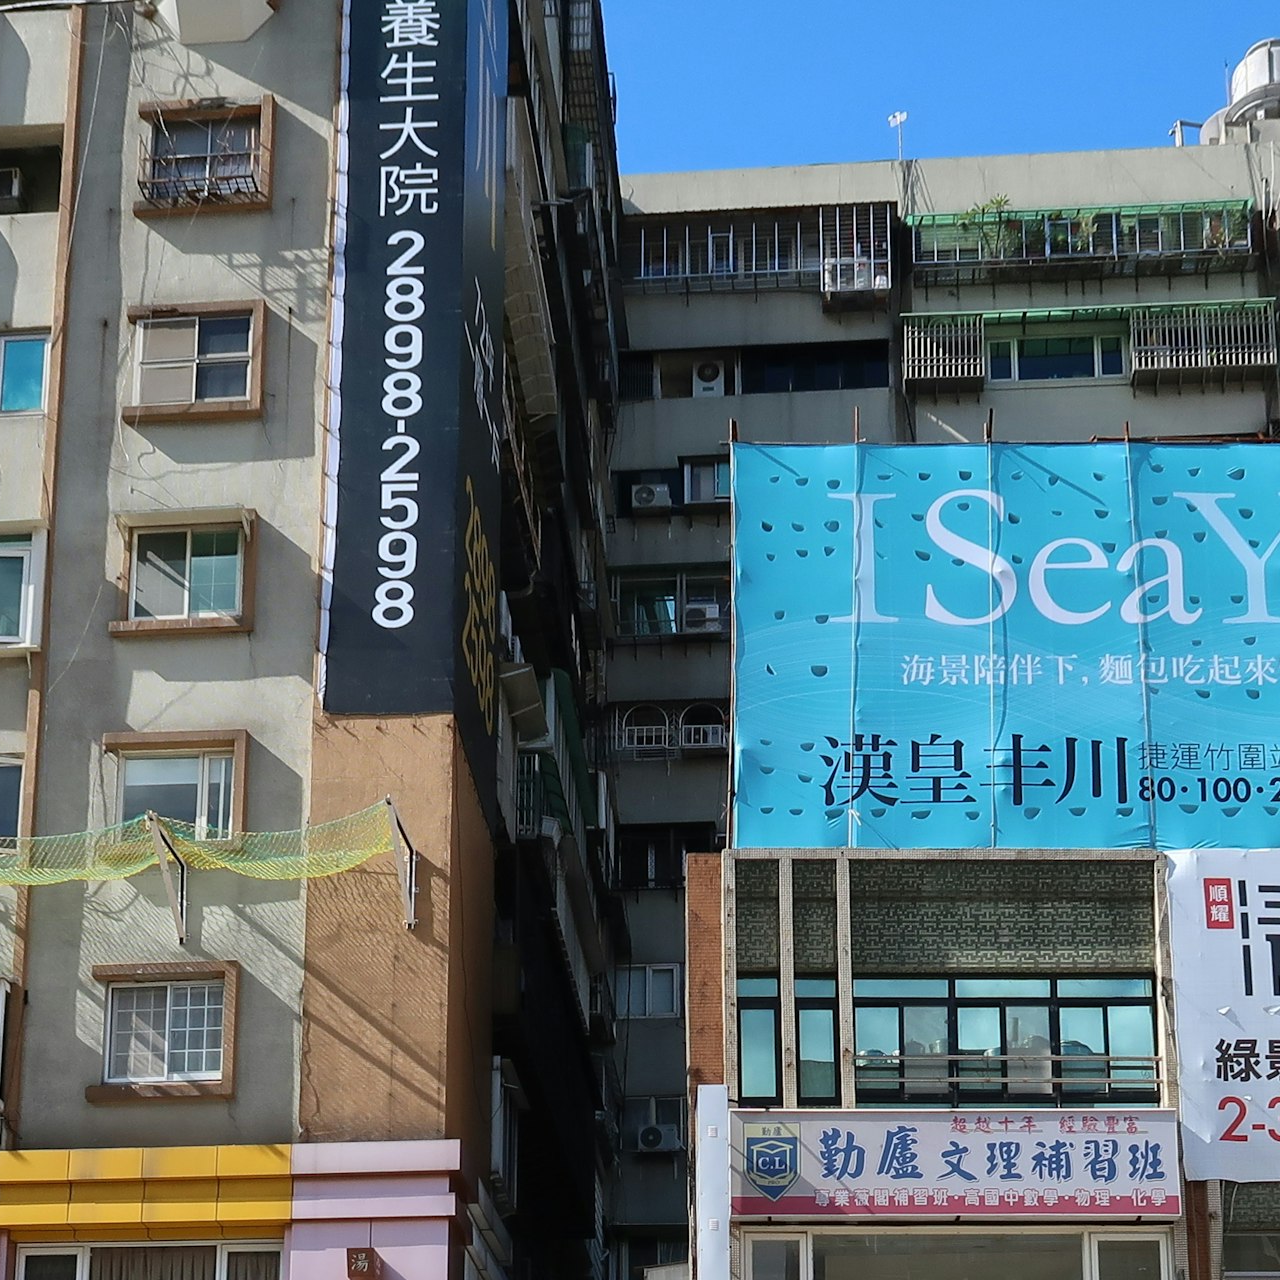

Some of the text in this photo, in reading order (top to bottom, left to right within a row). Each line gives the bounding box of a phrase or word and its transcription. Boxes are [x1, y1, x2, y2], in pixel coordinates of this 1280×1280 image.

[378, 0, 441, 217] 養生大院
[372, 230, 426, 629] 2898-2598
[950, 1114, 1140, 1135] 超越十年 經驗豐富
